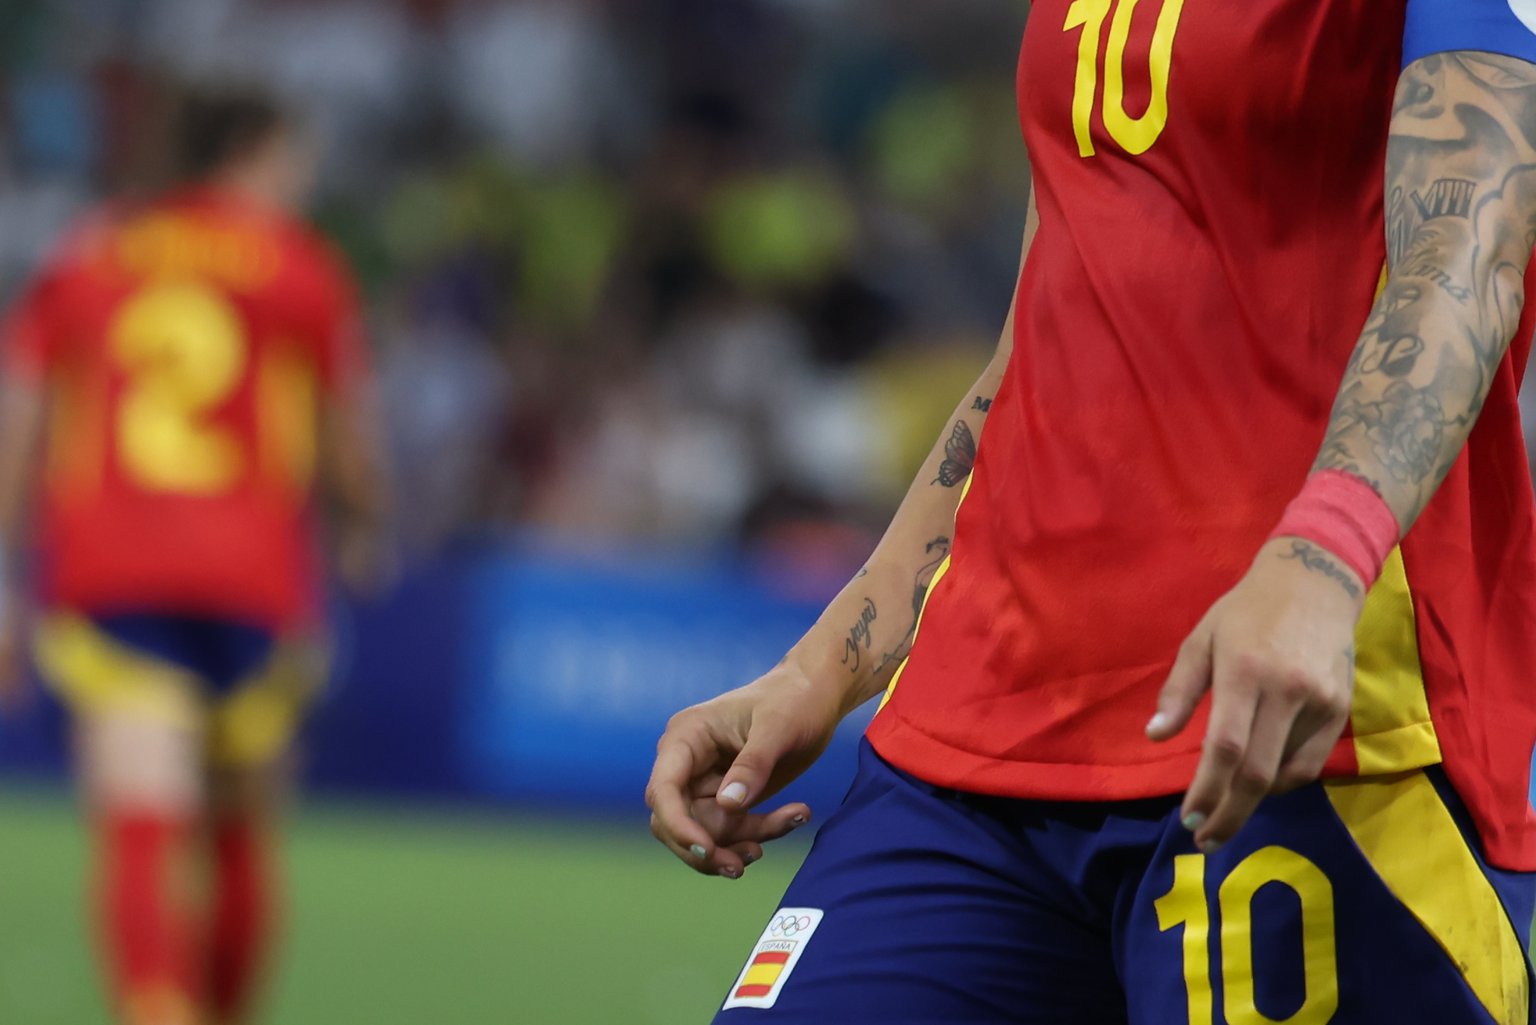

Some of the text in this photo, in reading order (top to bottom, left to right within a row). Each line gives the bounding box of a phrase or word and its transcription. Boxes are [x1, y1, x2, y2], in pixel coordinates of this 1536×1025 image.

[110, 284, 244, 498] 2
[760, 942, 792, 952] ESPAÑA
[1153, 844, 1339, 1025] 10
